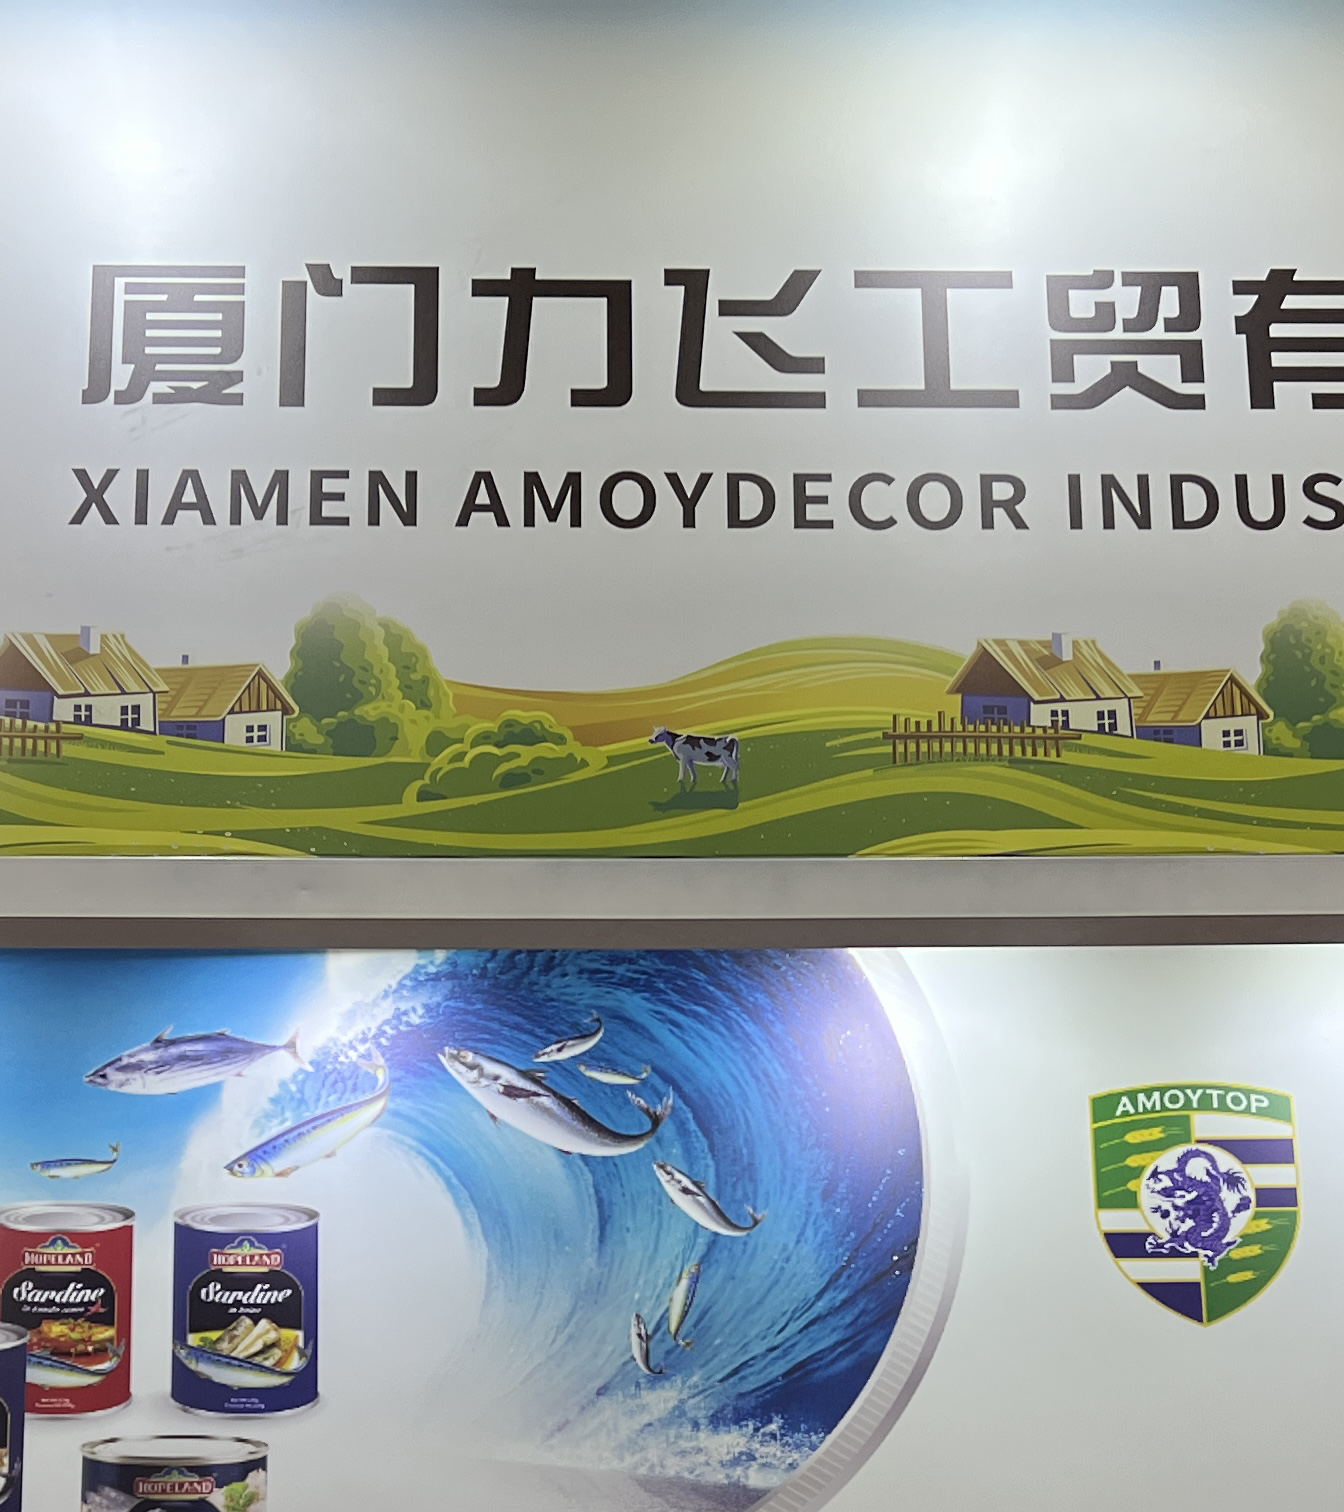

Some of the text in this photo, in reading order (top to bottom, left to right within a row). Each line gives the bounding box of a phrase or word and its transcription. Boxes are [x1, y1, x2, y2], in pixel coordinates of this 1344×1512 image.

[68, 467, 419, 532] XIAMEN
[453, 467, 1031, 532] AMOYDECOR
[1113, 1088, 1270, 1117] AMOYTOP
[23, 1249, 94, 1268] HOPELAND
[210, 1250, 283, 1269] HOPELAND
[12, 1280, 106, 1306] Sardine
[200, 1281, 293, 1307] Sardine
[135, 1477, 214, 1497] HOPELAND
